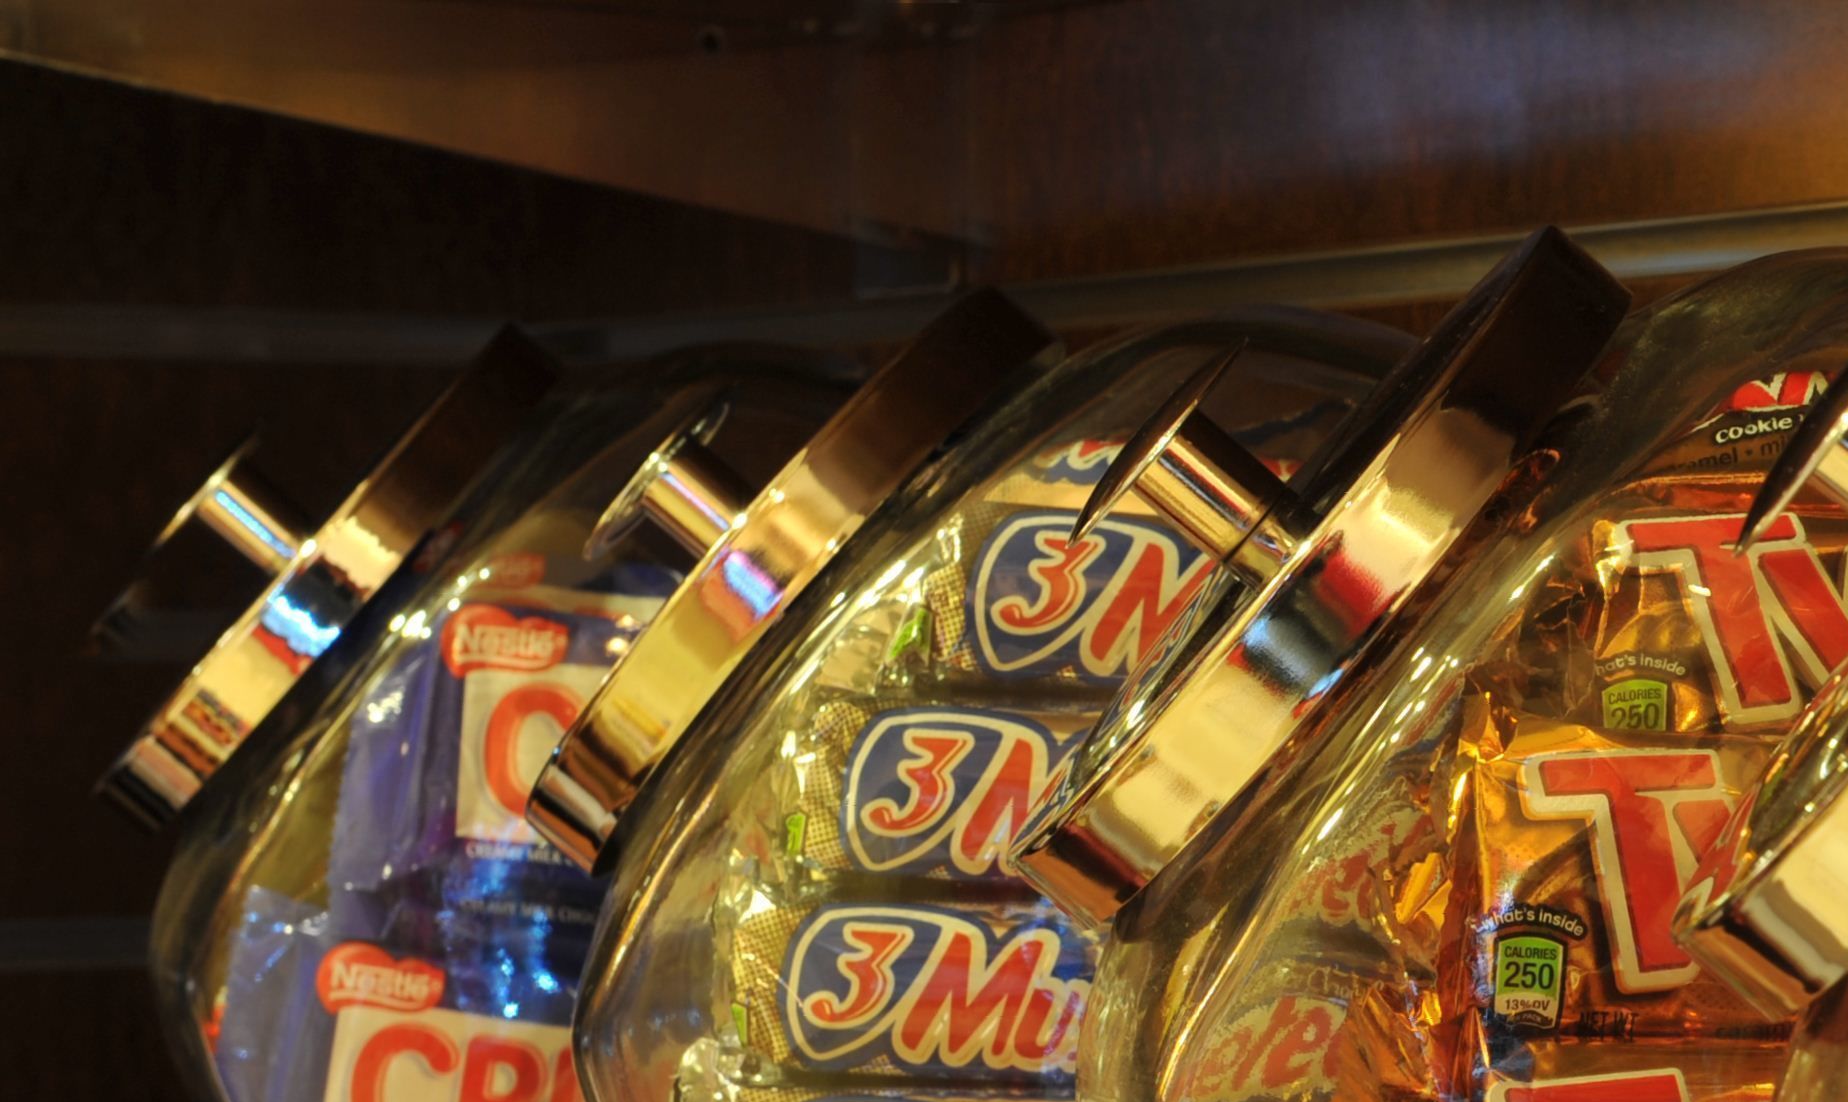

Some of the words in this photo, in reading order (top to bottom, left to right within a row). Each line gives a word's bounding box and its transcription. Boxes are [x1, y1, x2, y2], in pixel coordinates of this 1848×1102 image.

[1714, 412, 1794, 445] cookie
[992, 531, 1105, 634] 3
[454, 617, 560, 660] Nestlé
[1594, 652, 1637, 677] hat's
[1638, 653, 1687, 677] inside
[1607, 686, 1663, 705] CALORIES
[1610, 701, 1662, 731] 250
[863, 729, 975, 836] 3
[1474, 906, 1536, 931] what's
[1538, 908, 1585, 937] inside
[1504, 945, 1557, 961] CALORIES
[329, 960, 435, 998] Nestlé
[1503, 961, 1555, 990] 250
[802, 922, 914, 1030] 3
[891, 923, 1094, 1071] Mu
